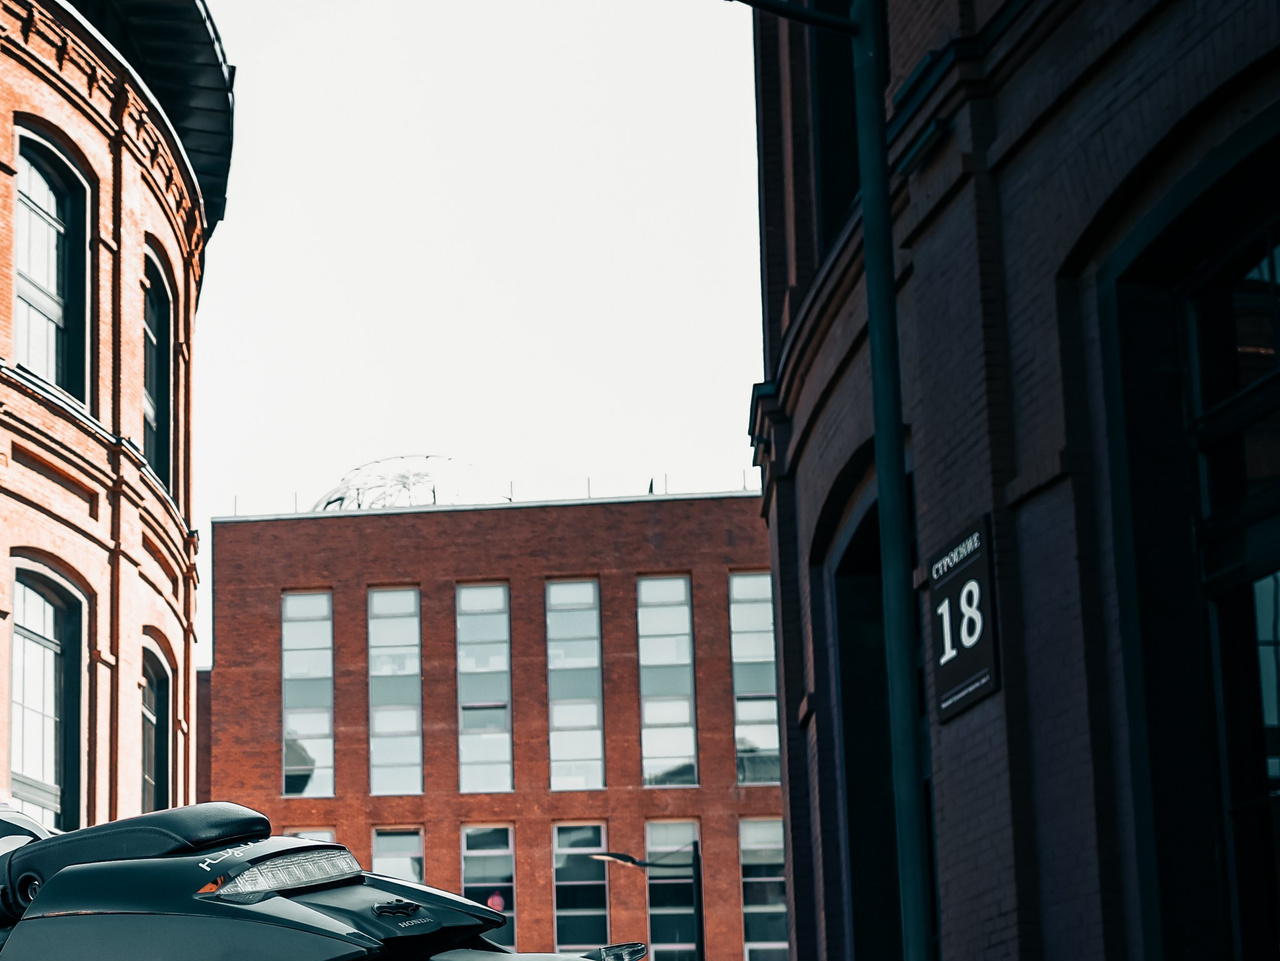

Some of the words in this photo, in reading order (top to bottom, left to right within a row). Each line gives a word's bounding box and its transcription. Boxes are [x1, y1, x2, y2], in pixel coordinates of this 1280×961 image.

[932, 531, 981, 580] СТРОЕНИЕ
[937, 579, 983, 666] 18
[398, 917, 434, 928] HONDA
